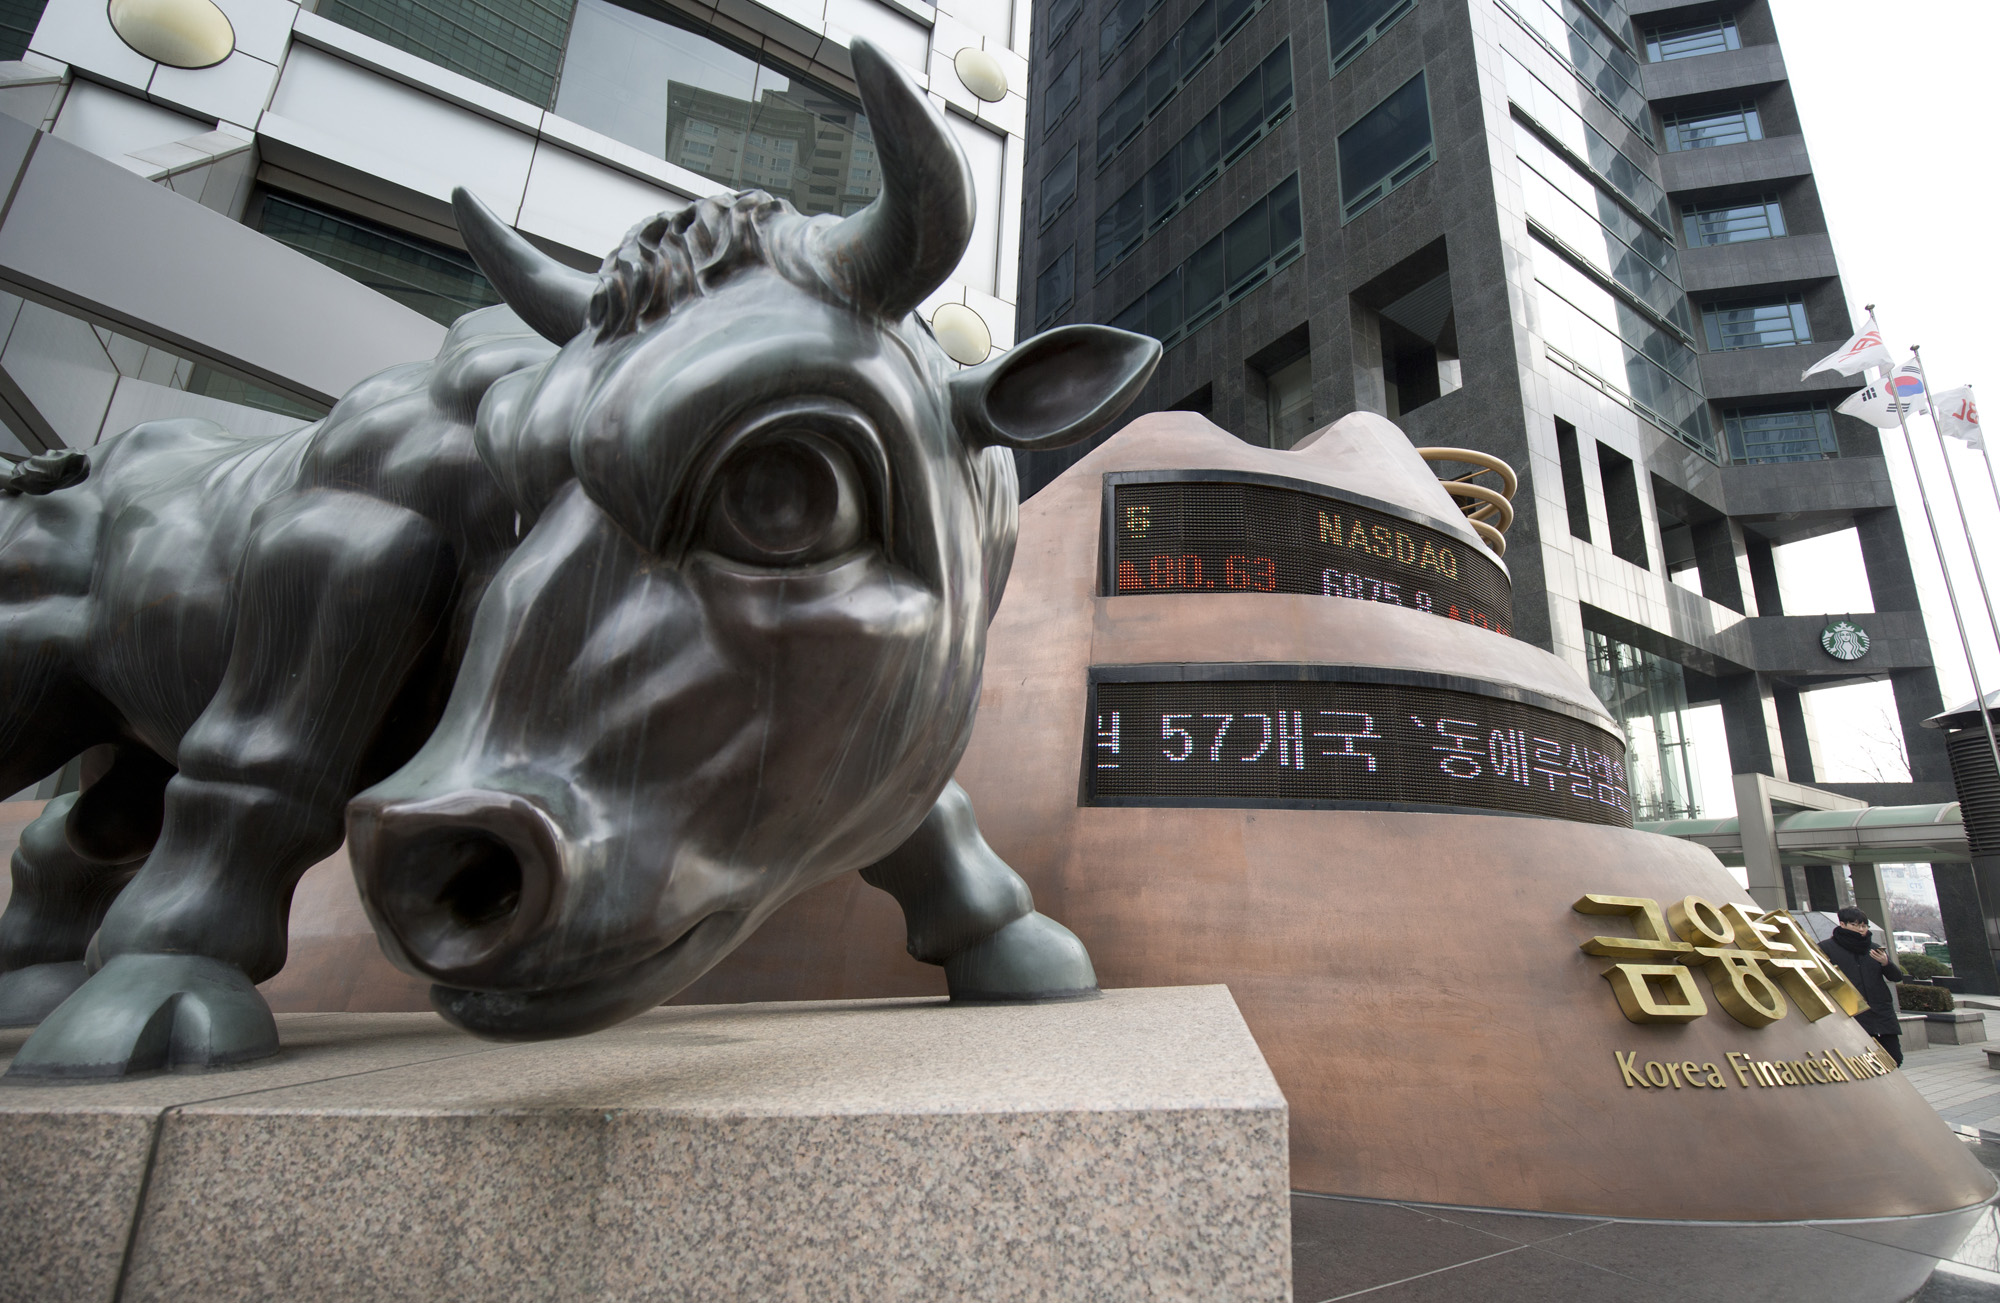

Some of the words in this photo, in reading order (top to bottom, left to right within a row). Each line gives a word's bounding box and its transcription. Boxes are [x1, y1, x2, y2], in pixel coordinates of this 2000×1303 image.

[1318, 511, 1458, 581] NASDAQ
[1162, 710, 1382, 772] 57개국
[1614, 1050, 1727, 1088] Korea
[1724, 1048, 1850, 1087] Financial
